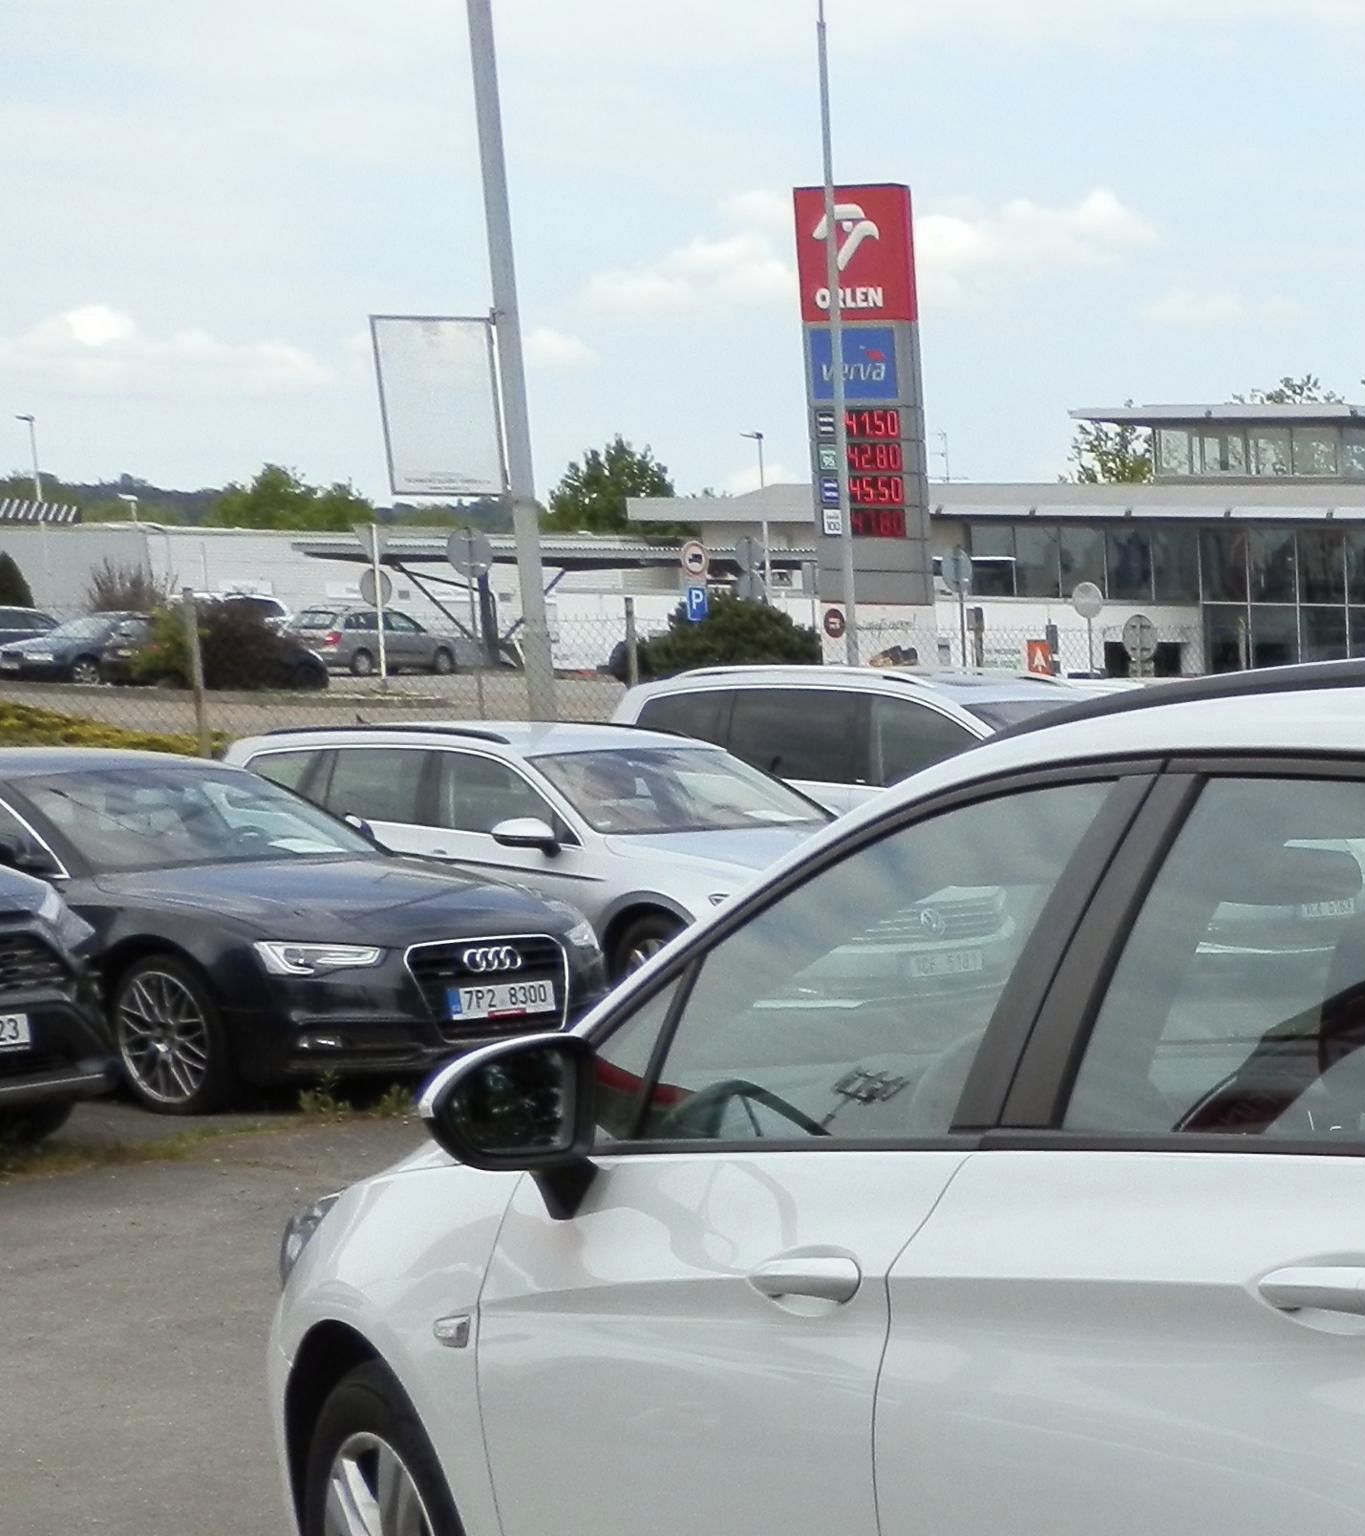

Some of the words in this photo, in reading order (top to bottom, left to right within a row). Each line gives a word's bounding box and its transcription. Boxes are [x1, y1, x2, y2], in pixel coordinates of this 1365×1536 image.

[691, 589, 704, 610] P
[463, 988, 497, 1010] 7P2
[508, 984, 547, 1006] 8300
